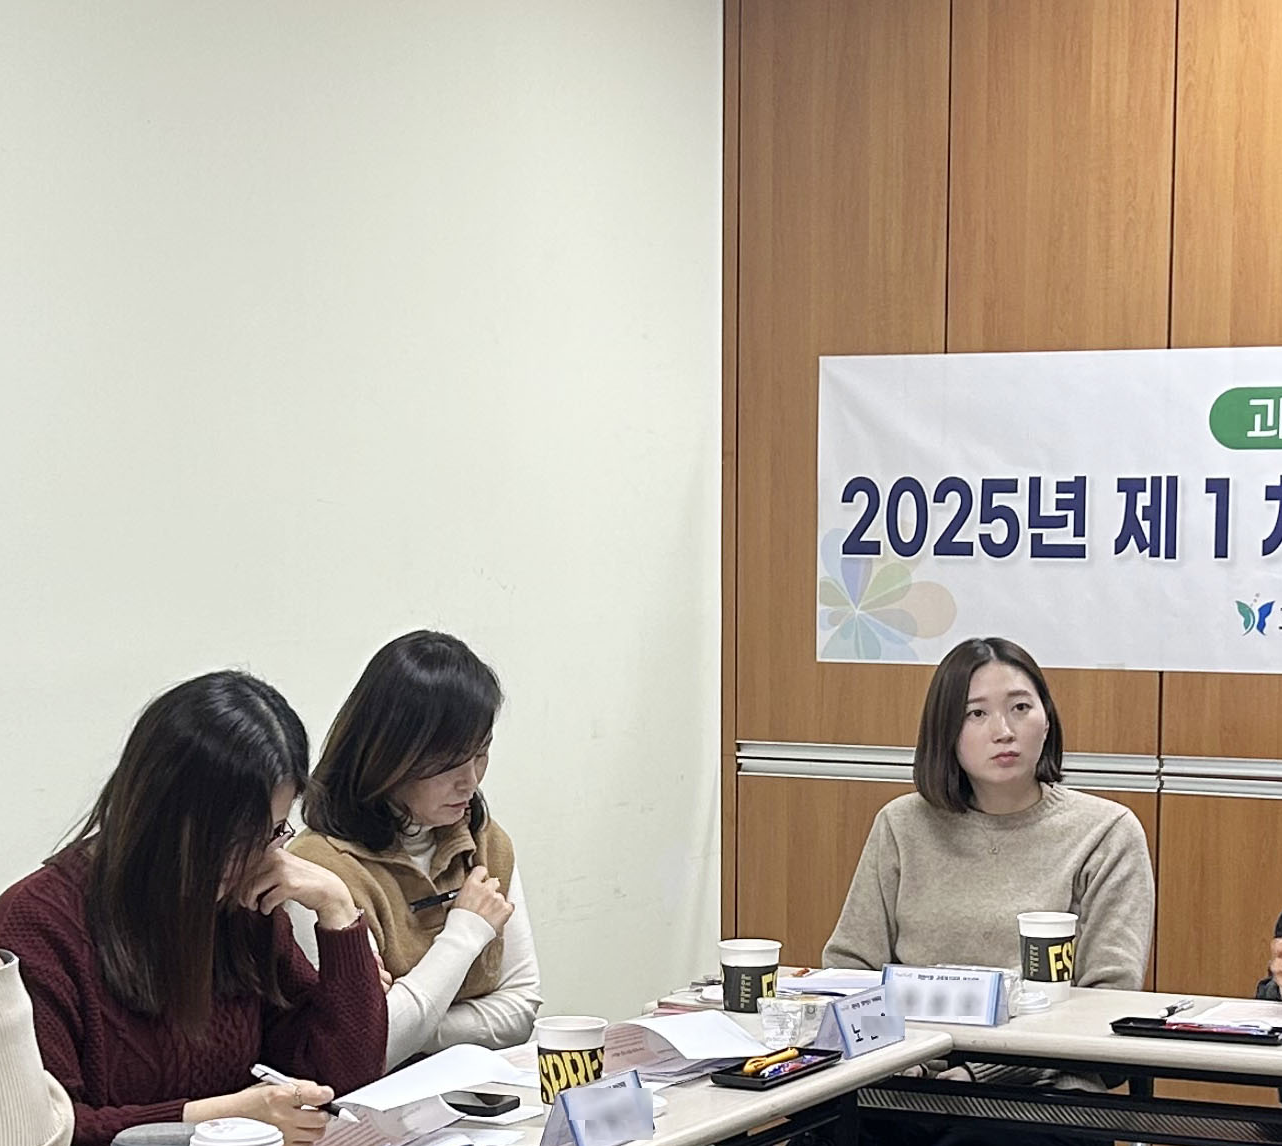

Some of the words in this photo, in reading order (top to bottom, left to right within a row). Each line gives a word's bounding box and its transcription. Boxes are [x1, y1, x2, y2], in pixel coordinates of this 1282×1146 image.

[840, 474, 1088, 559] 2025년
[1114, 474, 1178, 560] 제
[1204, 476, 1231, 559] 1
